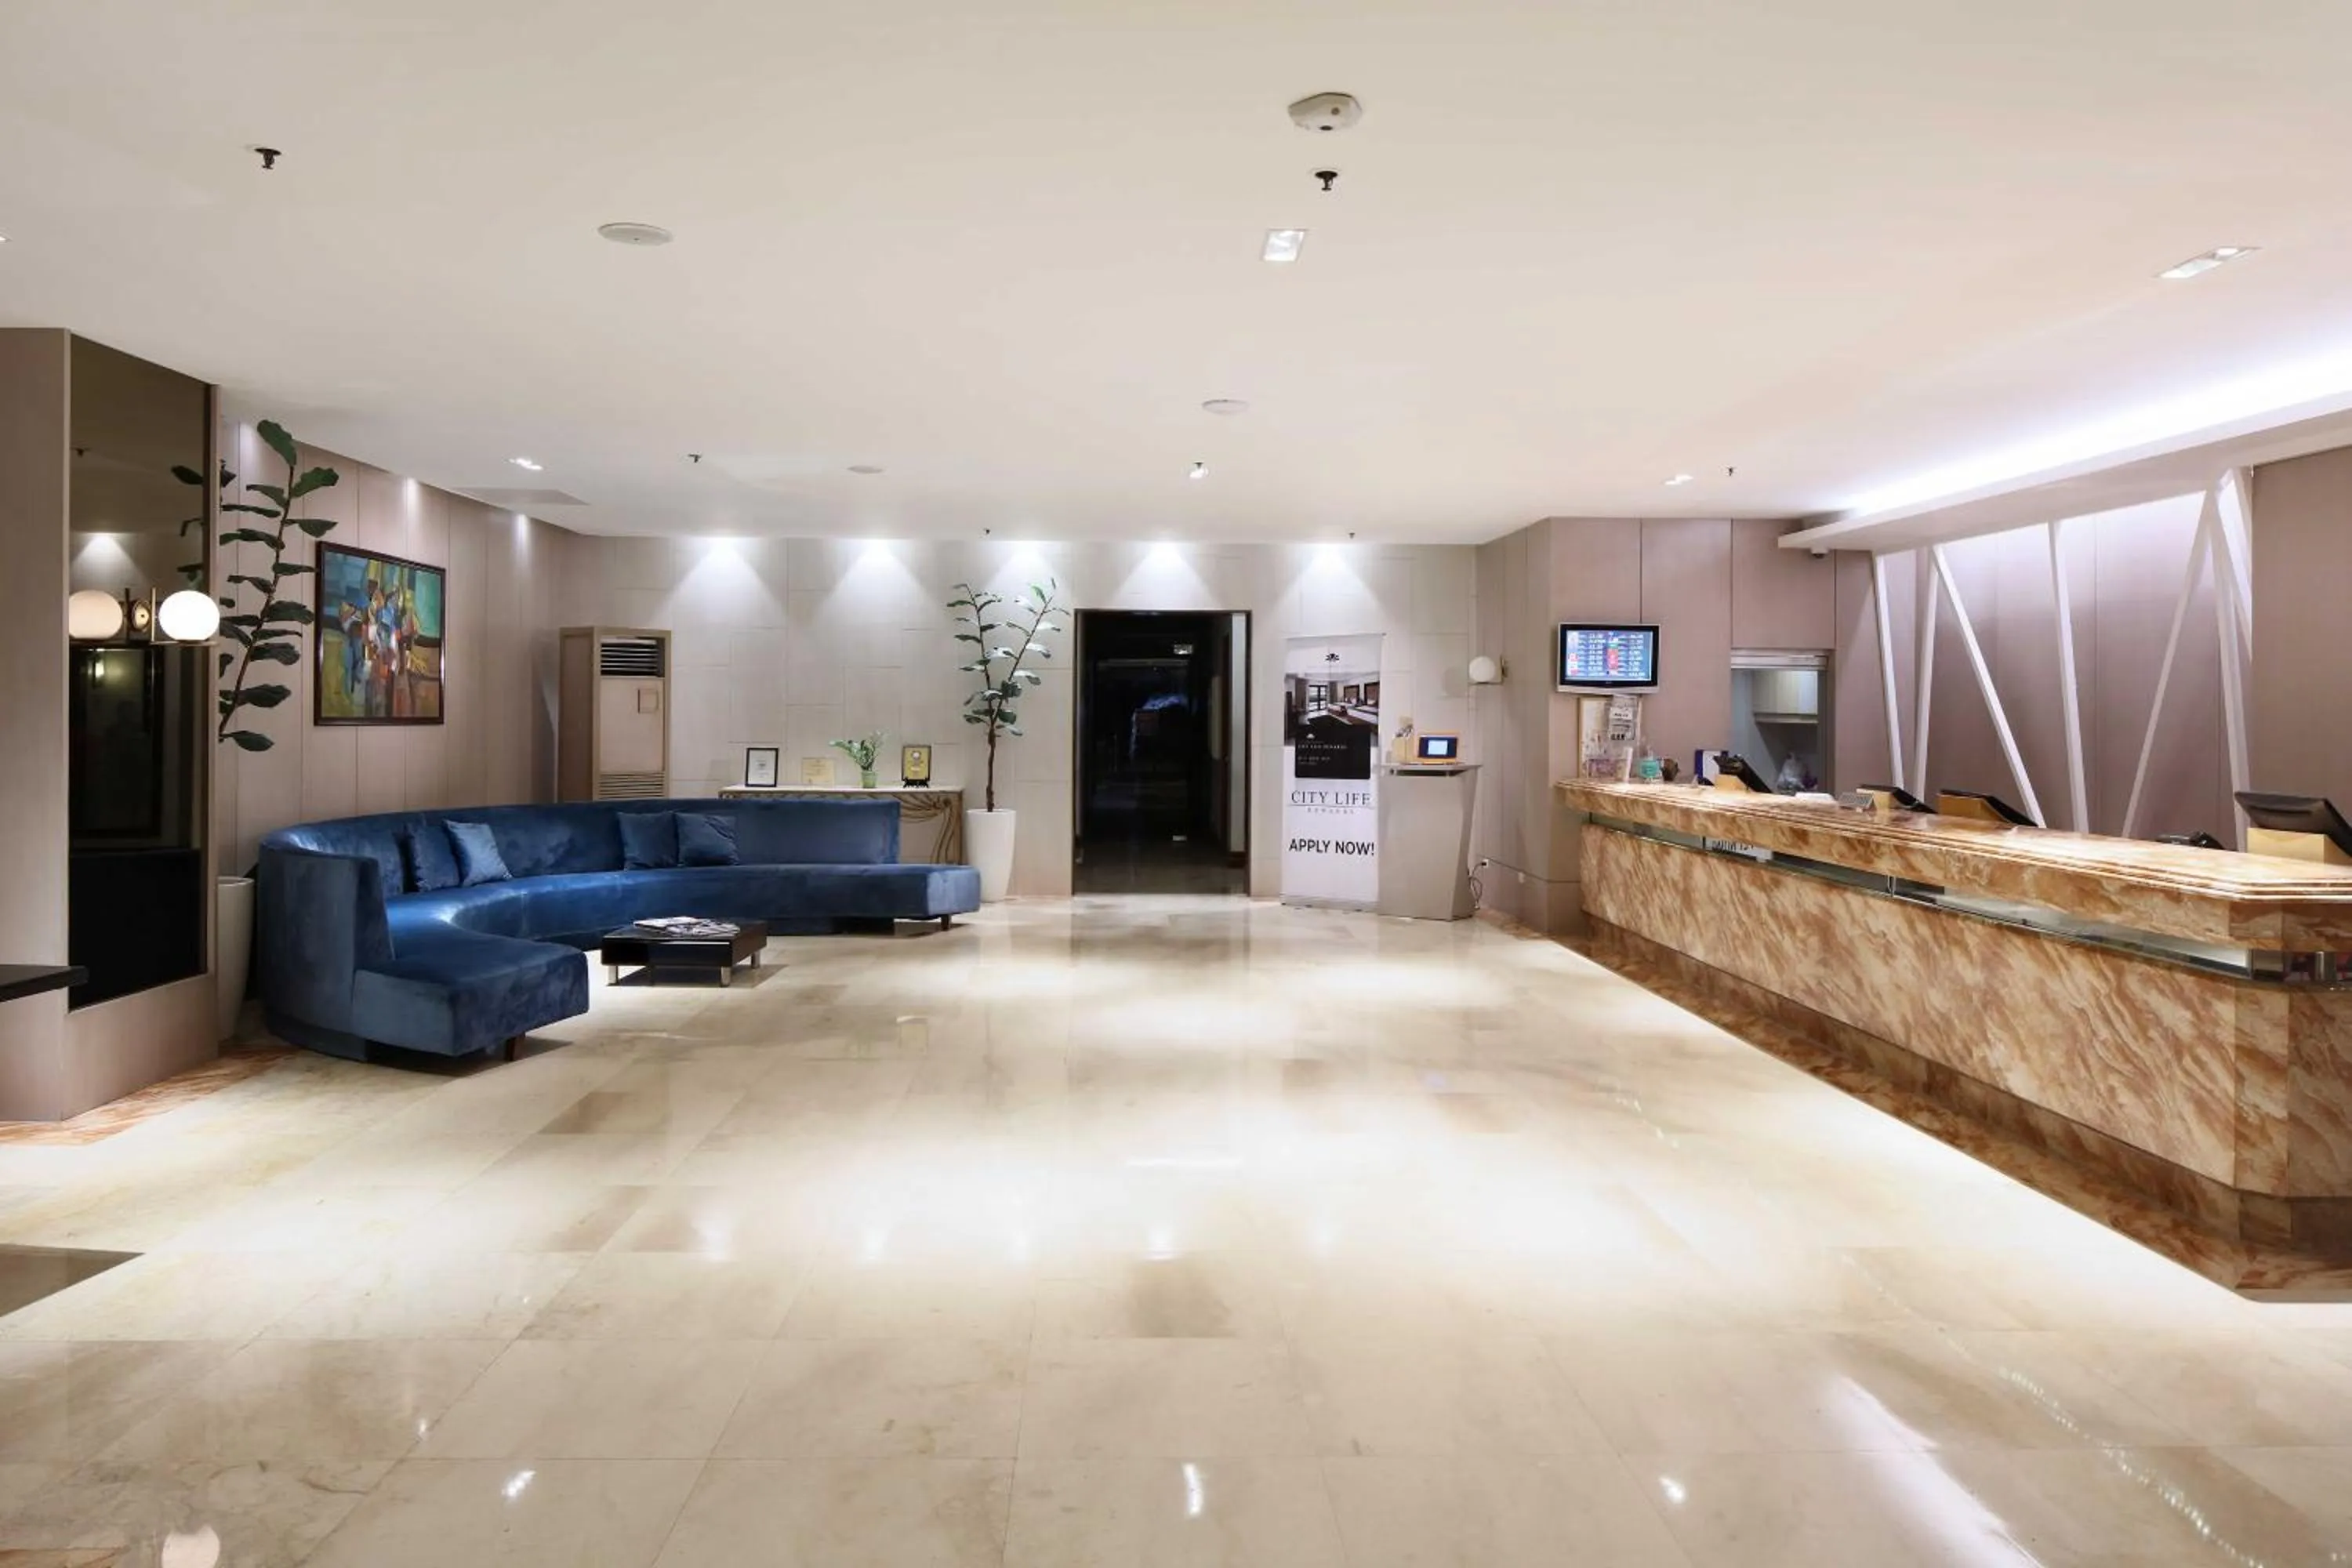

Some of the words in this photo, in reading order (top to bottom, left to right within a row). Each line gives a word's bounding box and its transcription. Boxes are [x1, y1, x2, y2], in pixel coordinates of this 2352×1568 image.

[1290, 790, 1328, 804] CITY
[1334, 792, 1371, 805] LIFE
[1288, 837, 1330, 853] APPLY
[1335, 840, 1374, 855] NOW!
